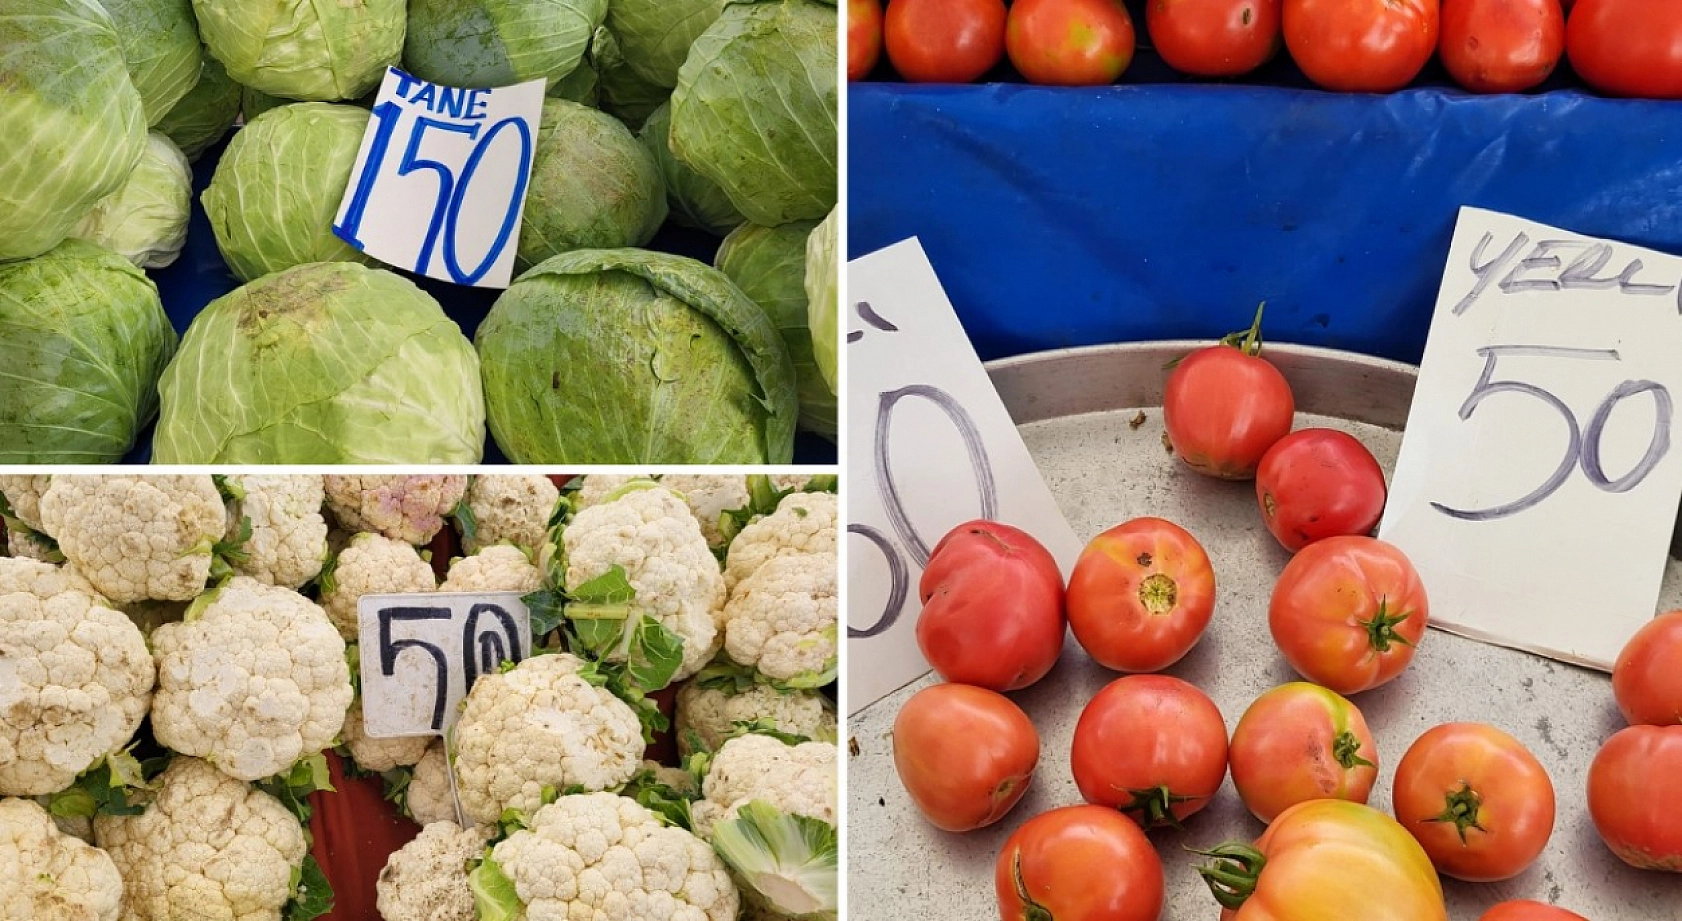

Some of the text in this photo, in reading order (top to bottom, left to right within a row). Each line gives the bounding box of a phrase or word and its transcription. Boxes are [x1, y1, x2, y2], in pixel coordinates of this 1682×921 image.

[390, 66, 492, 119] TANE
[331, 101, 531, 286] 150
[1452, 231, 1682, 317] YERL
[1430, 345, 1674, 521] 50
